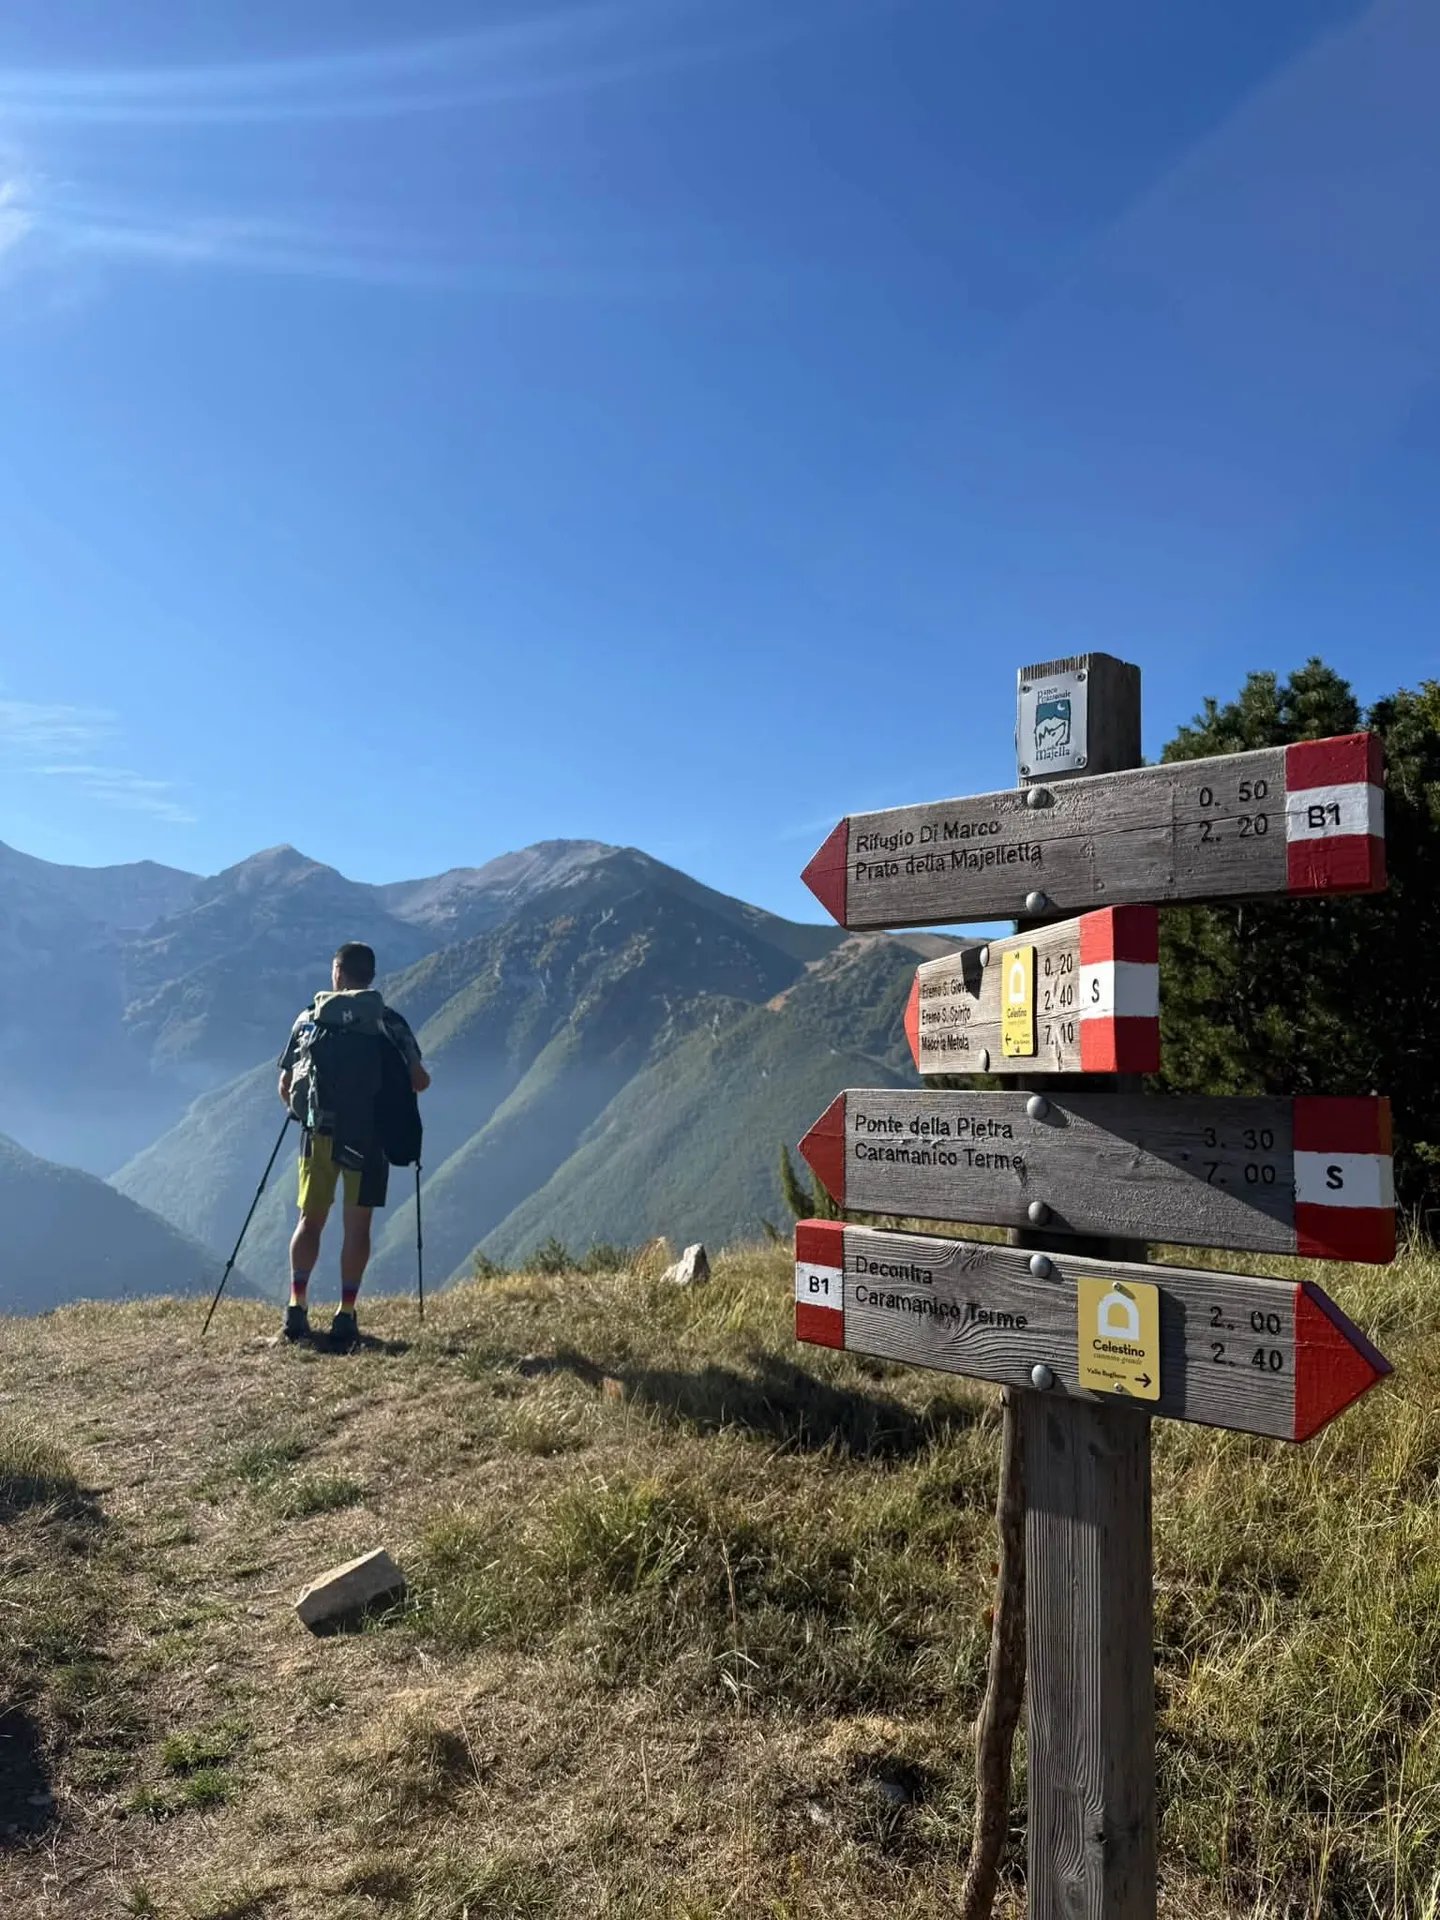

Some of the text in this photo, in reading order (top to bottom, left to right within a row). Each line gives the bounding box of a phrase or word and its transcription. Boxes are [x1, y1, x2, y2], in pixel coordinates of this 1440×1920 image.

[1199, 779, 1268, 807] 0. 50
[1200, 813, 1268, 842] 2. 20
[1308, 802, 1341, 828] B1
[856, 820, 1000, 853] Rifugio Di Marco
[855, 843, 1043, 881] Prato della Majelletta
[1044, 953, 1073, 977] 0. 20
[1044, 984, 1073, 1011] 2. 40
[1091, 978, 1100, 1003] S
[1045, 1022, 1073, 1045] 7. 10
[855, 1114, 1013, 1139] Ponte della Pietra
[1203, 1126, 1274, 1150] 3. 30
[855, 1143, 1023, 1169] Caramanico Terme
[1202, 1161, 1275, 1184] 7. 00
[1326, 1165, 1344, 1190] S
[856, 1256, 932, 1284] Decontra
[809, 1276, 829, 1294] B1
[855, 1286, 1028, 1329] Caramanico Terme
[1210, 1306, 1281, 1335] 2. 00
[1092, 1339, 1145, 1357] Celestino
[1210, 1342, 1283, 1371] 2. 40
